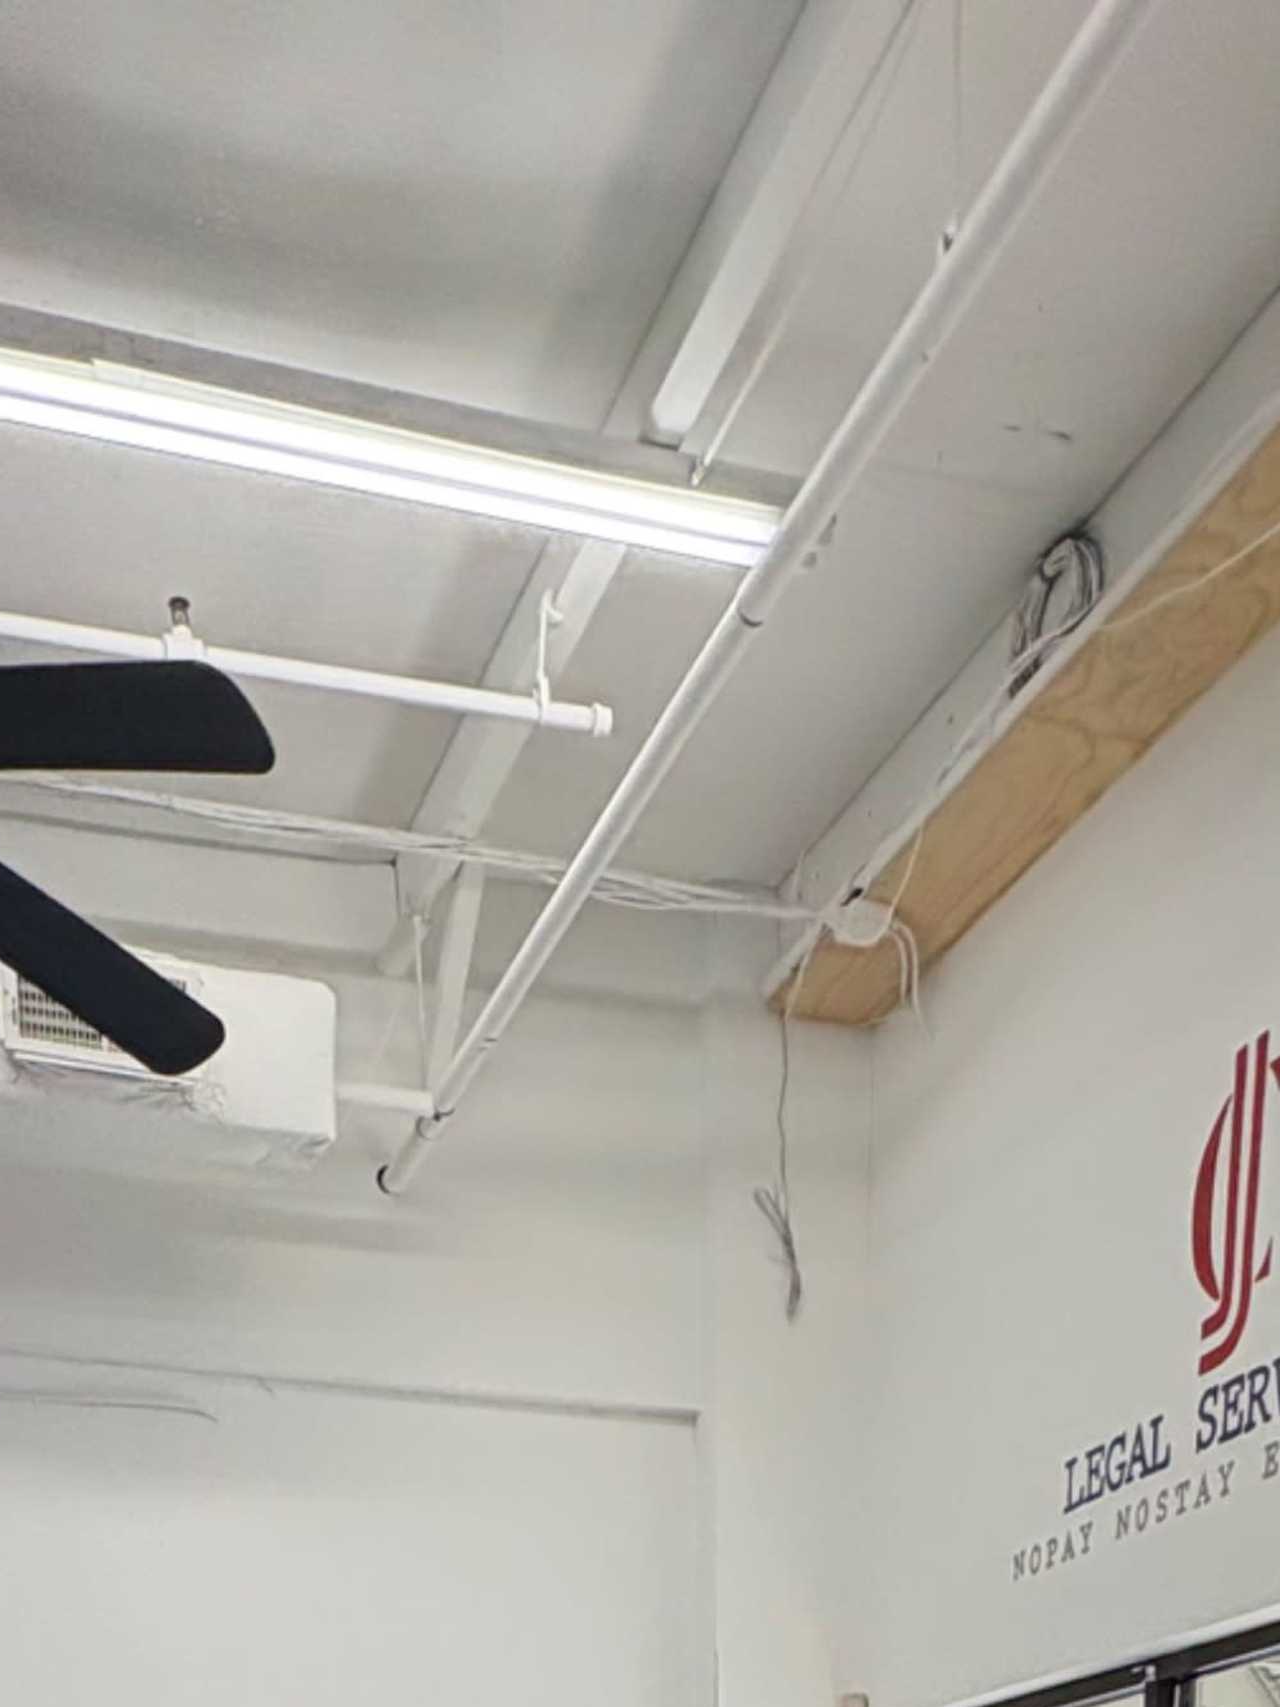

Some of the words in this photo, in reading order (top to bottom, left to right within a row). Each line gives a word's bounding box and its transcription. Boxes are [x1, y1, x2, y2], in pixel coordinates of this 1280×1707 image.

[1012, 1520, 1094, 1580] NOPAY
[1114, 1459, 1236, 1541] NOSTAY
[1062, 1413, 1172, 1515] LEGAL
